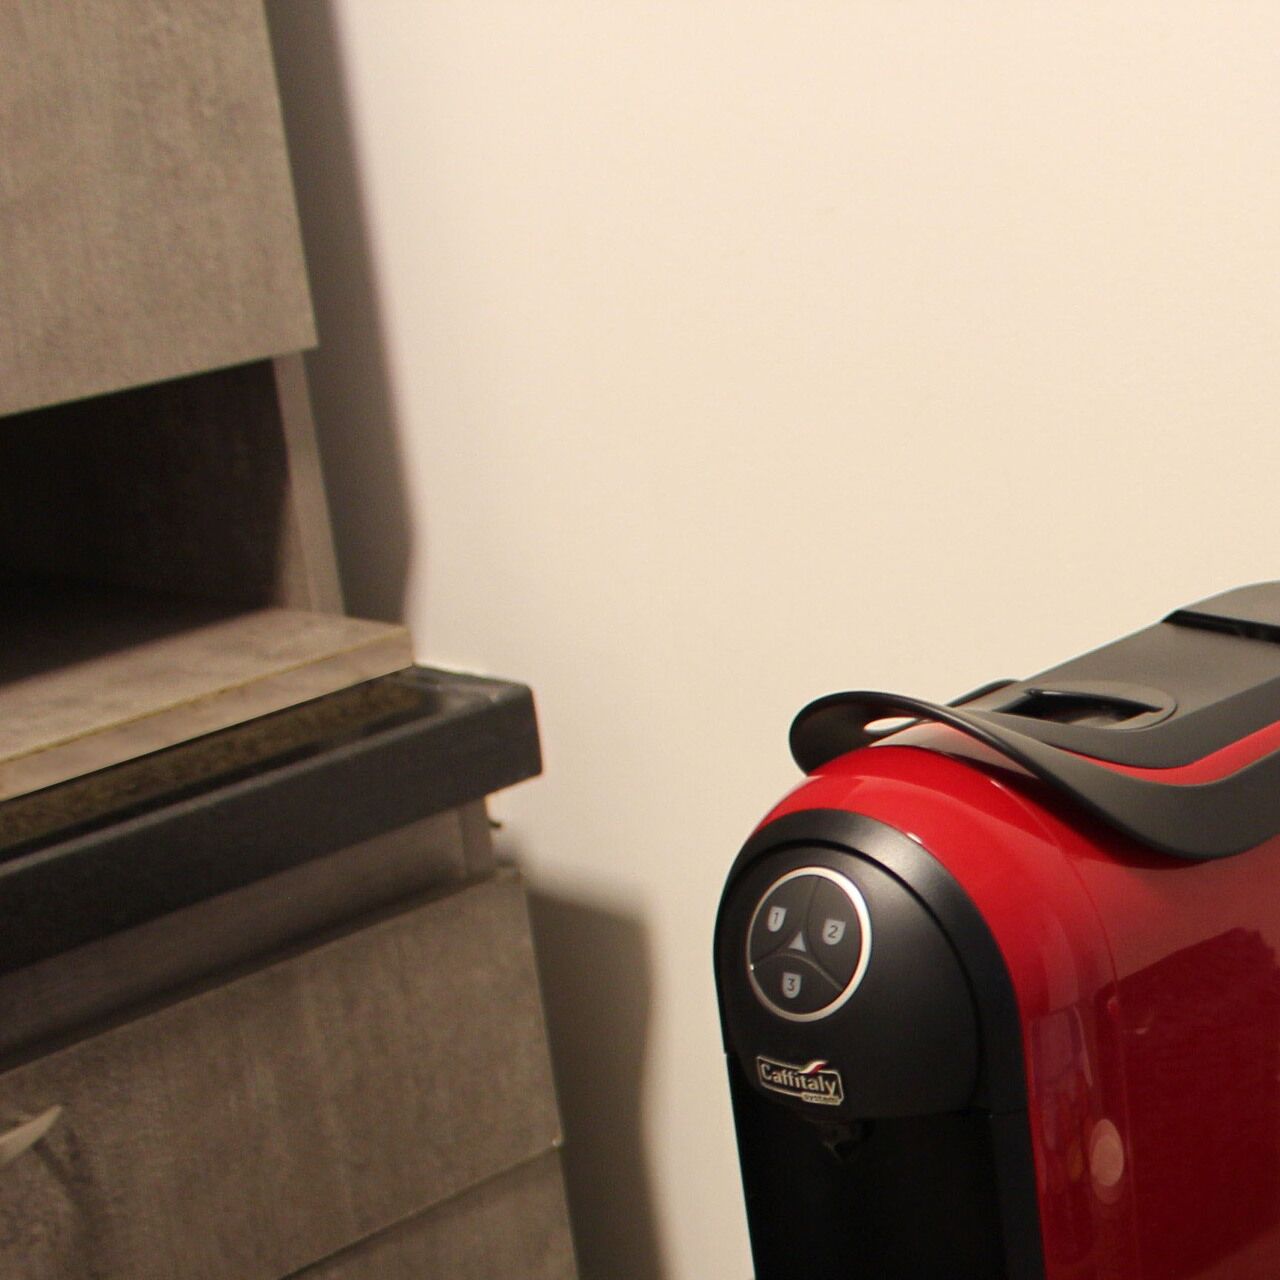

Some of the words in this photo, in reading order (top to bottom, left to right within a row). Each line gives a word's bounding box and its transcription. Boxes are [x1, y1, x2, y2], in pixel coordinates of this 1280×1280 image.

[827, 925, 838, 938] 2
[787, 978, 796, 992] 3
[760, 1063, 836, 1097] Caffitaly
